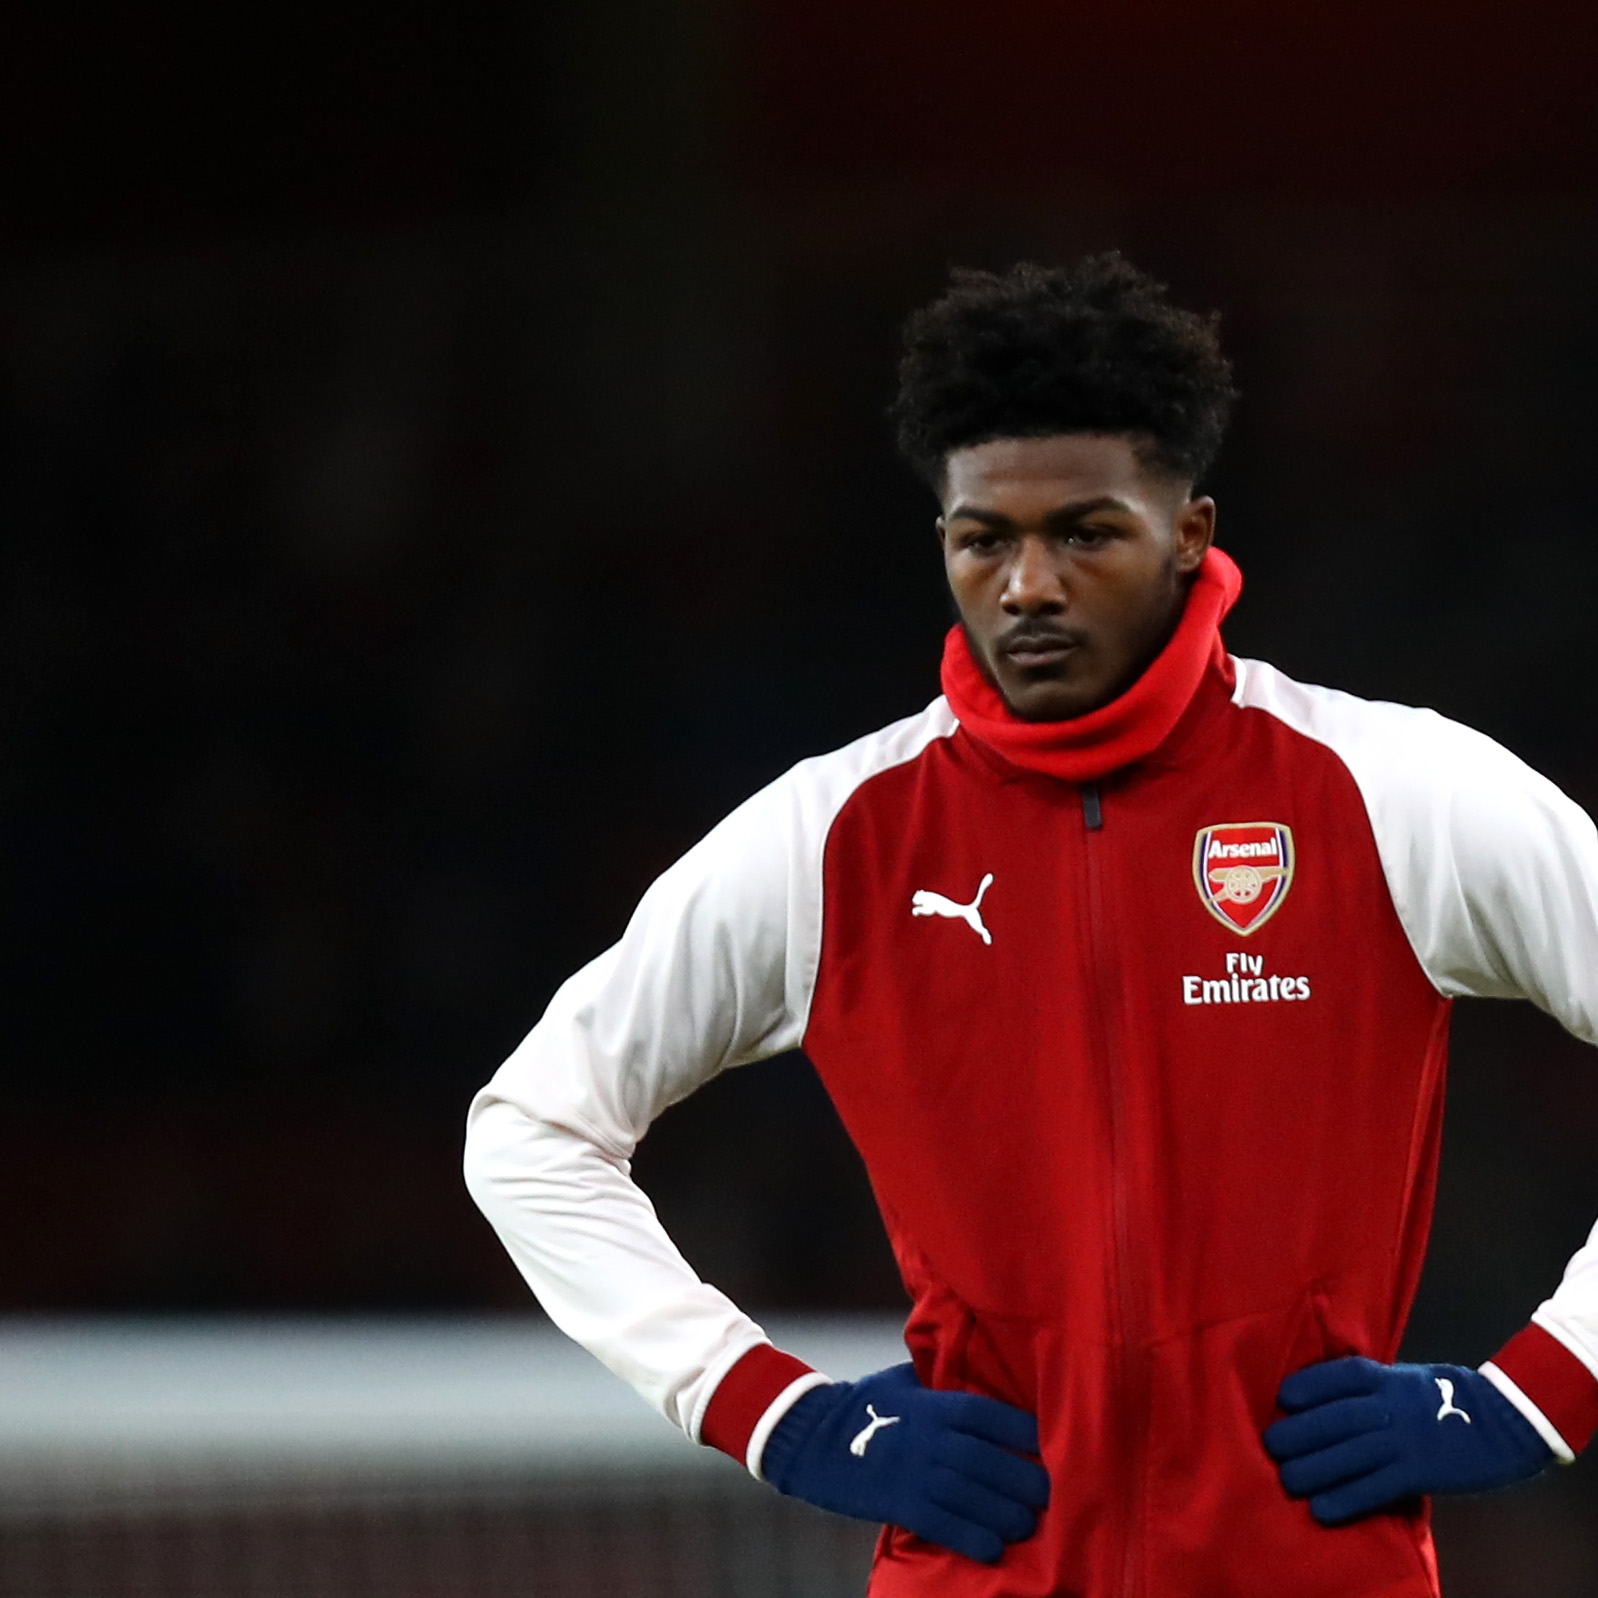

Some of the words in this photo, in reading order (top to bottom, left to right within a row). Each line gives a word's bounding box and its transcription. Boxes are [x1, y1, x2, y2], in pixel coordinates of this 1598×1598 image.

[1208, 837, 1277, 859] Arsenal
[1226, 952, 1263, 976] Fly
[1182, 973, 1311, 1005] Emirates
